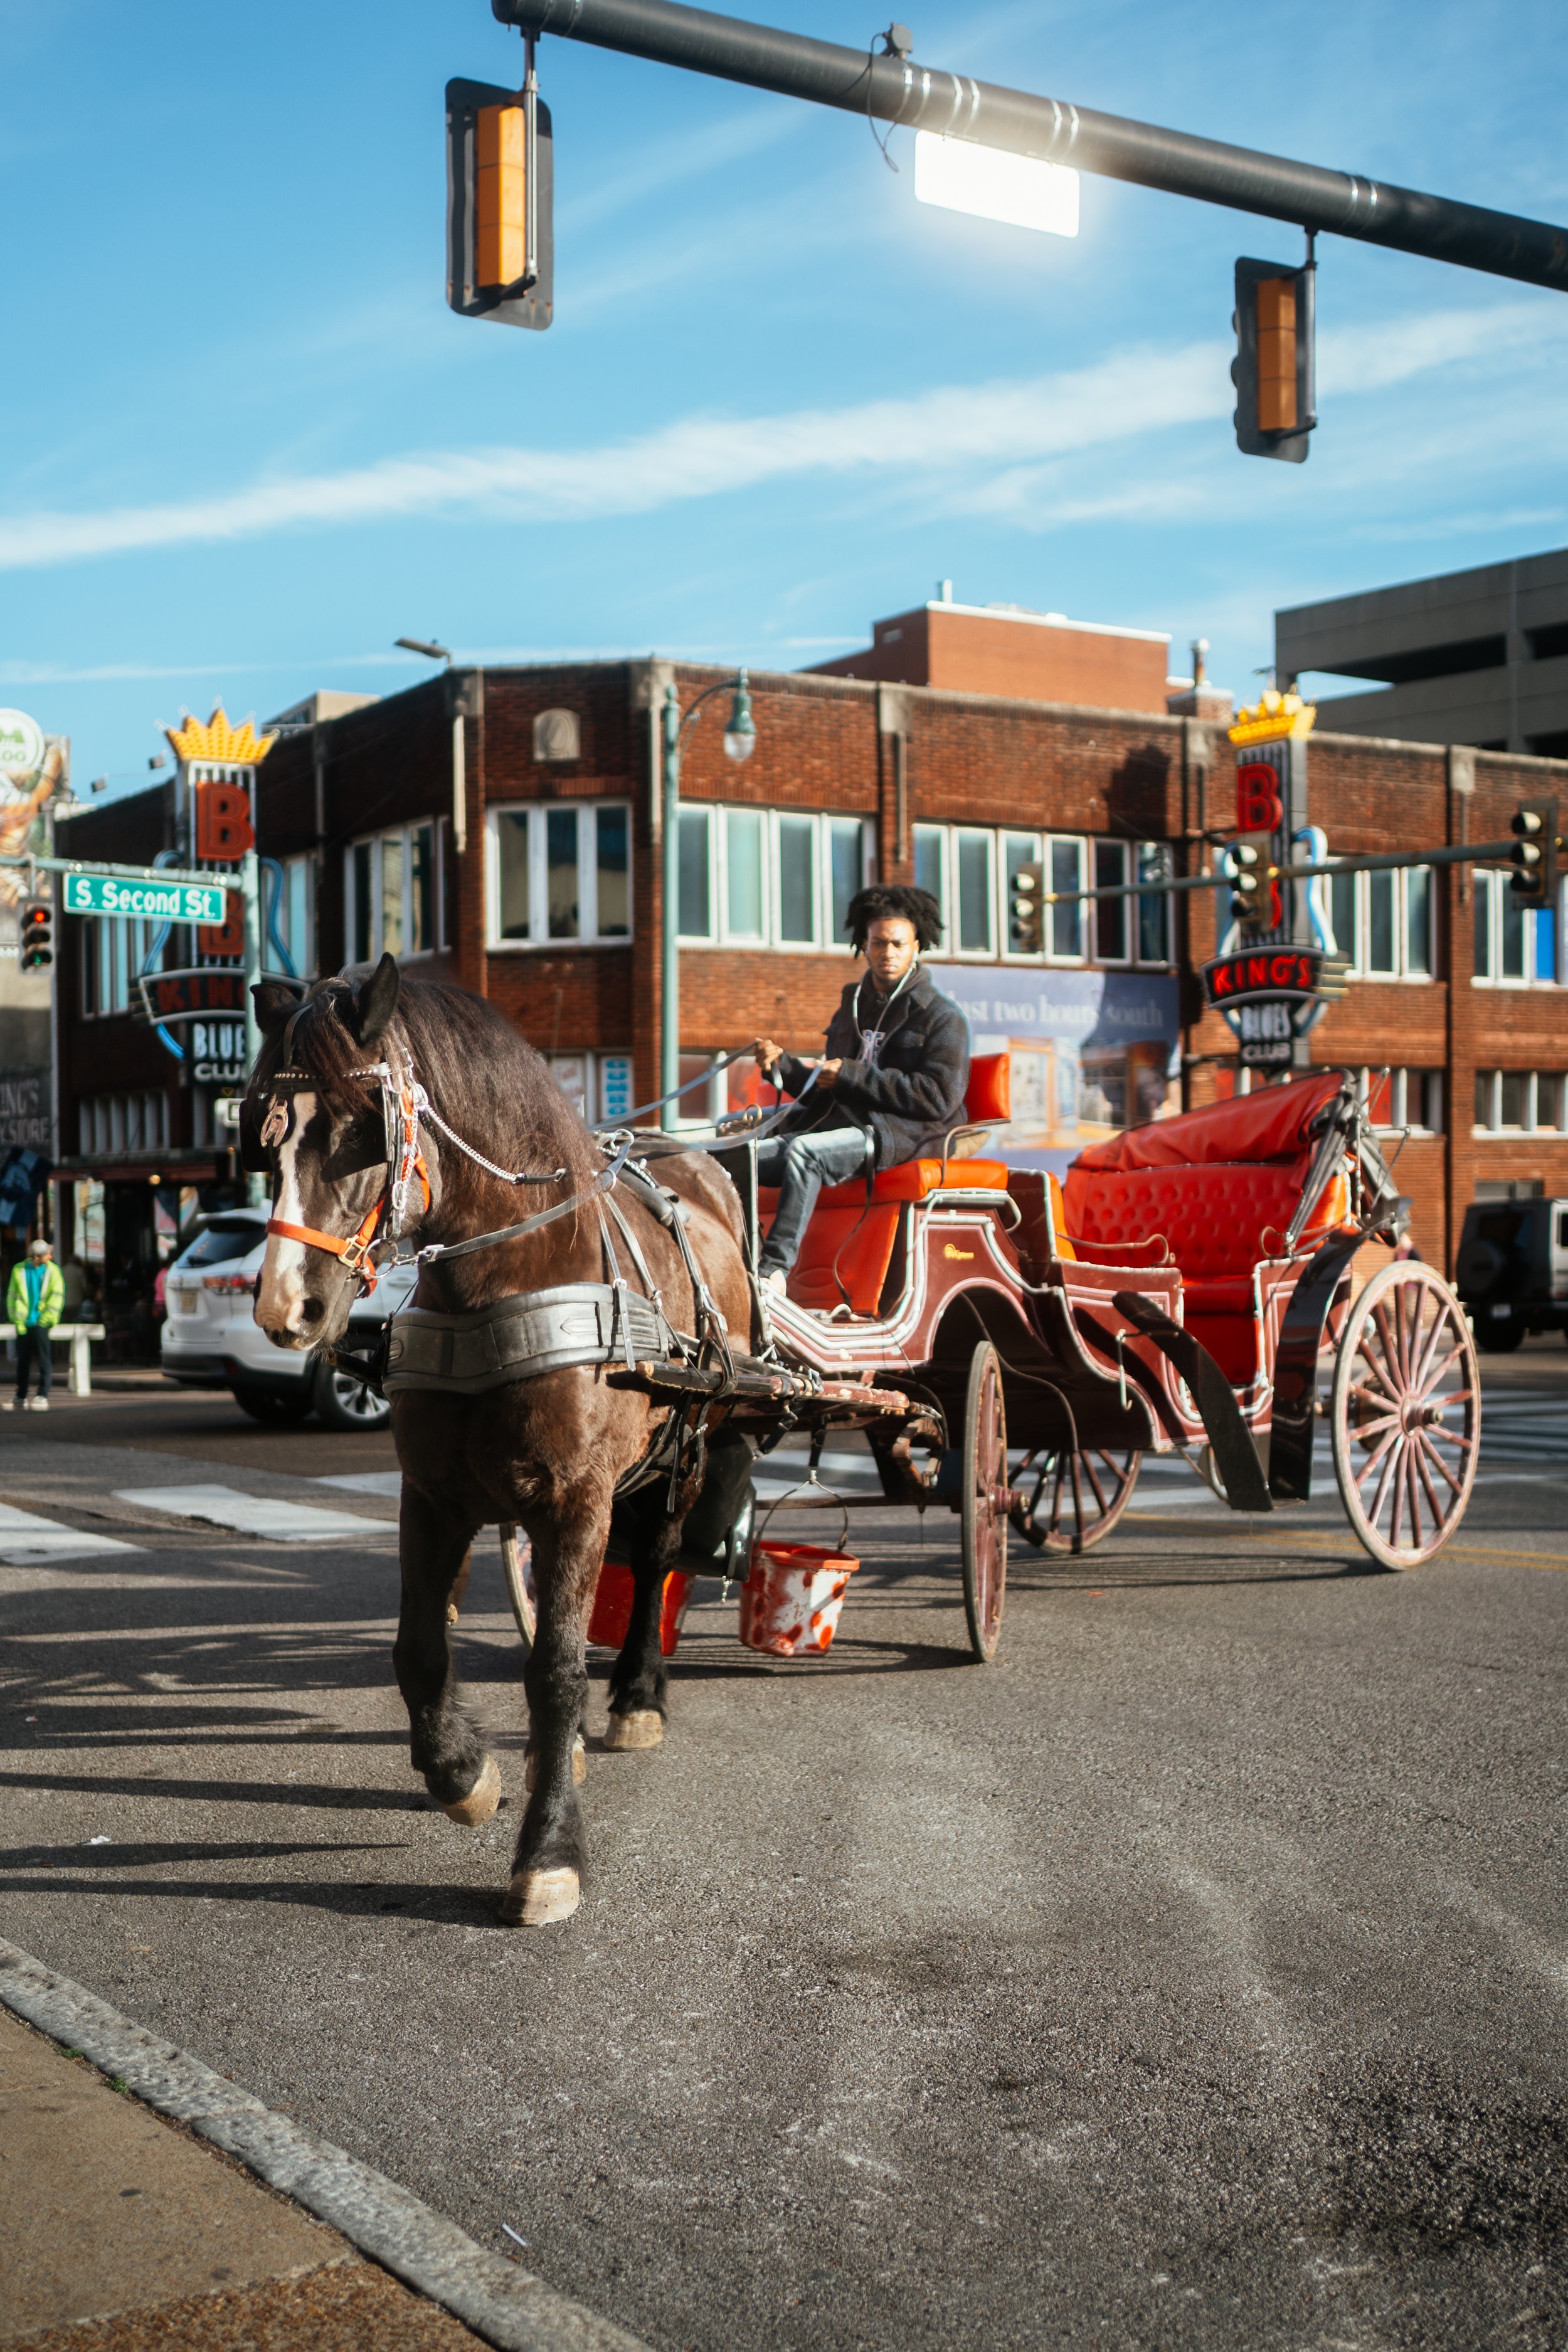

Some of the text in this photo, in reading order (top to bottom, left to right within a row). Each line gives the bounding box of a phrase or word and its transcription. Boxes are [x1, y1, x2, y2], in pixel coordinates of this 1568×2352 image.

[0, 750, 26, 763] OO
[75, 878, 216, 918] S. Second St.
[1212, 953, 1311, 996] KING'S
[157, 975, 245, 1011] KIN
[993, 1000, 1036, 1024] two
[1039, 994, 1099, 1024] hours
[1105, 999, 1164, 1028] south
[1241, 1002, 1292, 1040] BLUES
[193, 1022, 245, 1060] BLUE
[1242, 1041, 1291, 1064] CLUB
[194, 1062, 246, 1082] CLU
